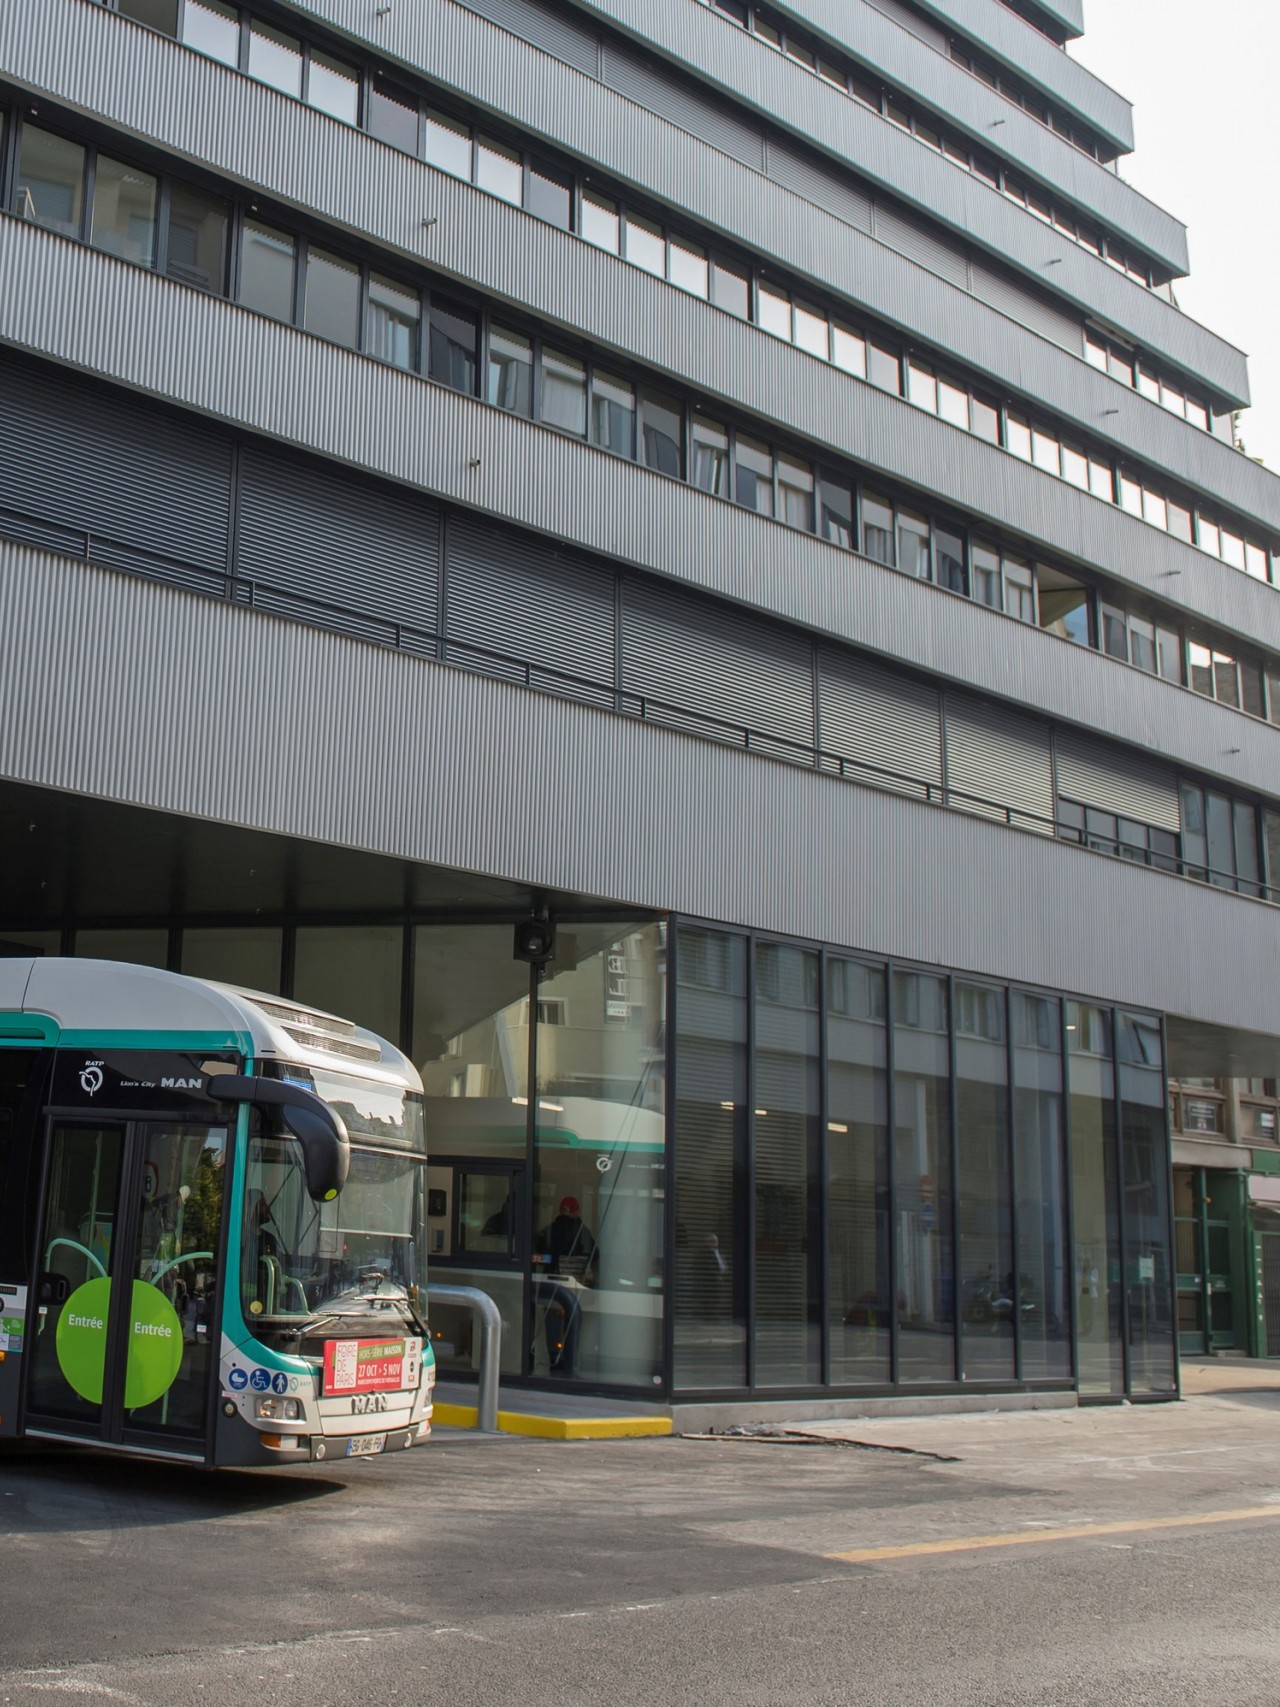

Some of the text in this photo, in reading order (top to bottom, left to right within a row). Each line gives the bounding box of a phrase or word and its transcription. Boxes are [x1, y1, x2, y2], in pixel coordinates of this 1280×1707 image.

[141, 1080, 156, 1088] City
[161, 1077, 202, 1089] MAN
[68, 1313, 103, 1329] Entrée
[134, 1321, 171, 1337] Entrée
[337, 1344, 357, 1358] FOIRE
[337, 1359, 346, 1372] DE
[358, 1363, 401, 1378] 27 OCT 5 NOV
[336, 1373, 354, 1387] PARIS
[352, 1393, 388, 1415] MAN
